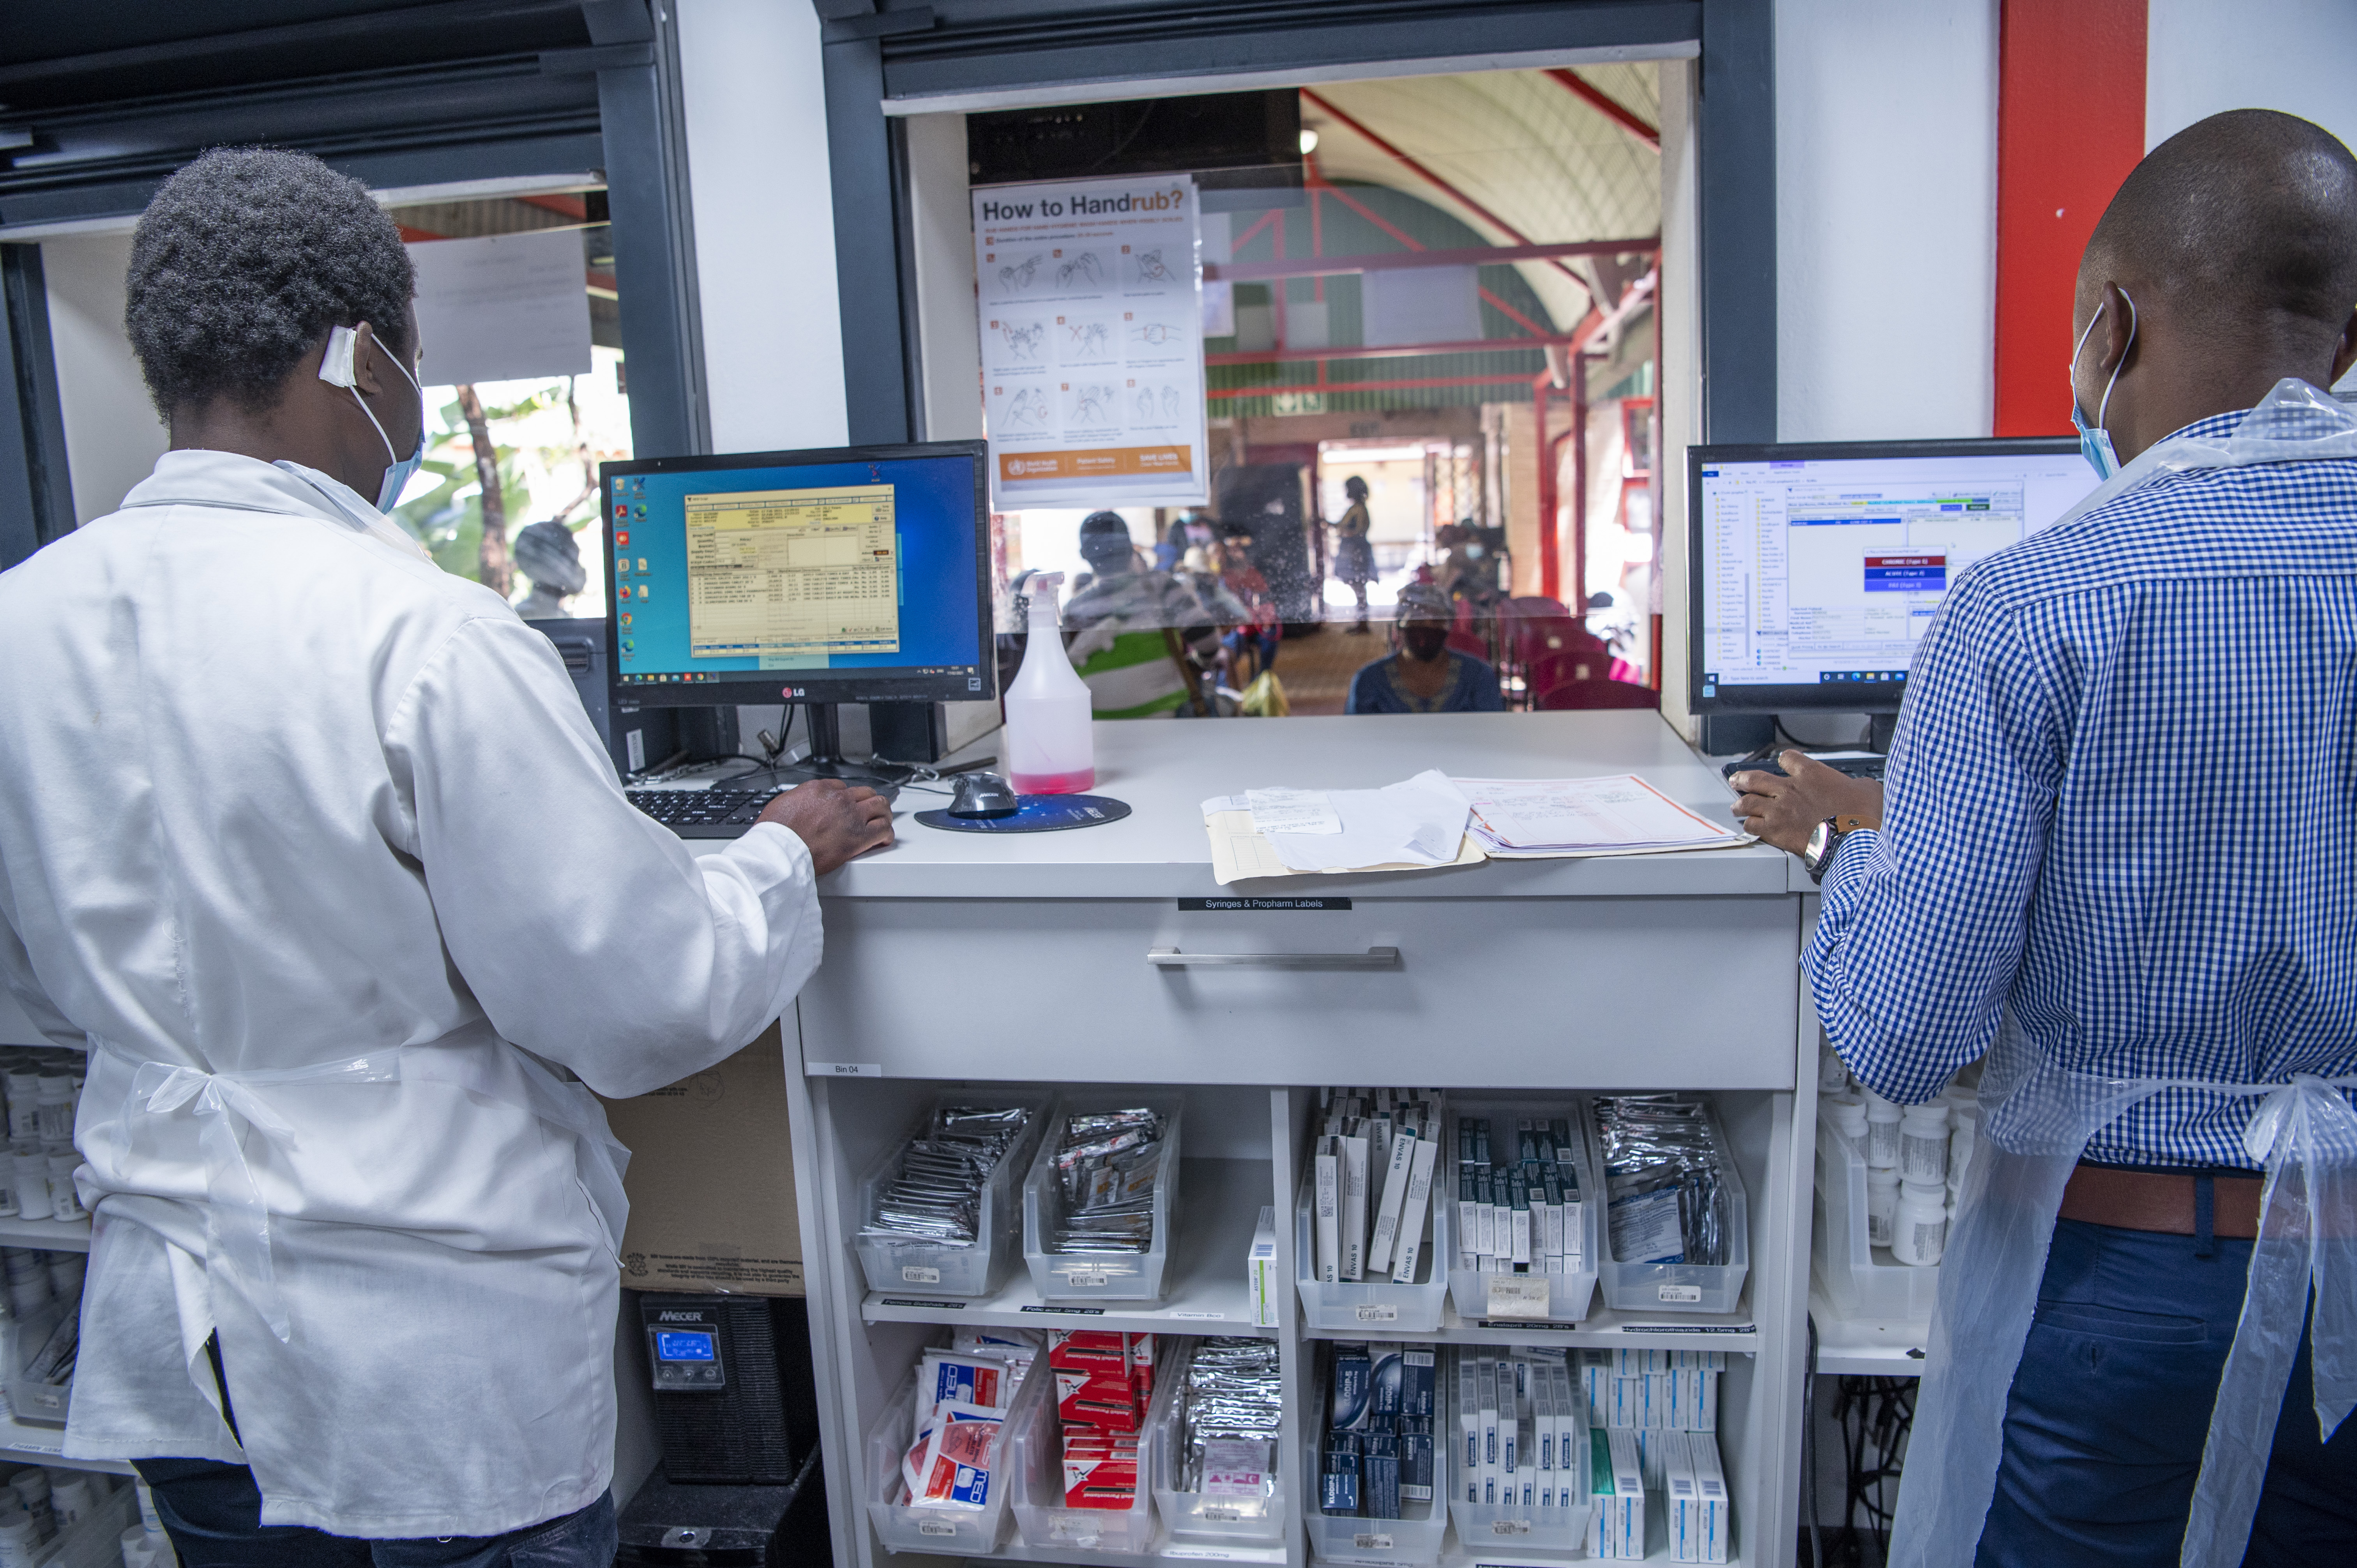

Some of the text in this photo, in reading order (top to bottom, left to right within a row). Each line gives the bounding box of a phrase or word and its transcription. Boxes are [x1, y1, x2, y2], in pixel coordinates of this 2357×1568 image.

[983, 189, 1183, 221] How to Handrub?
[793, 688, 805, 697] LG
[1206, 900, 1242, 908] Syringes
[1253, 900, 1293, 908] Propharm
[1395, 1137, 1406, 1161] ENVAS
[1403, 1255, 1412, 1278] ENVAS
[659, 1311, 702, 1321] MECER
